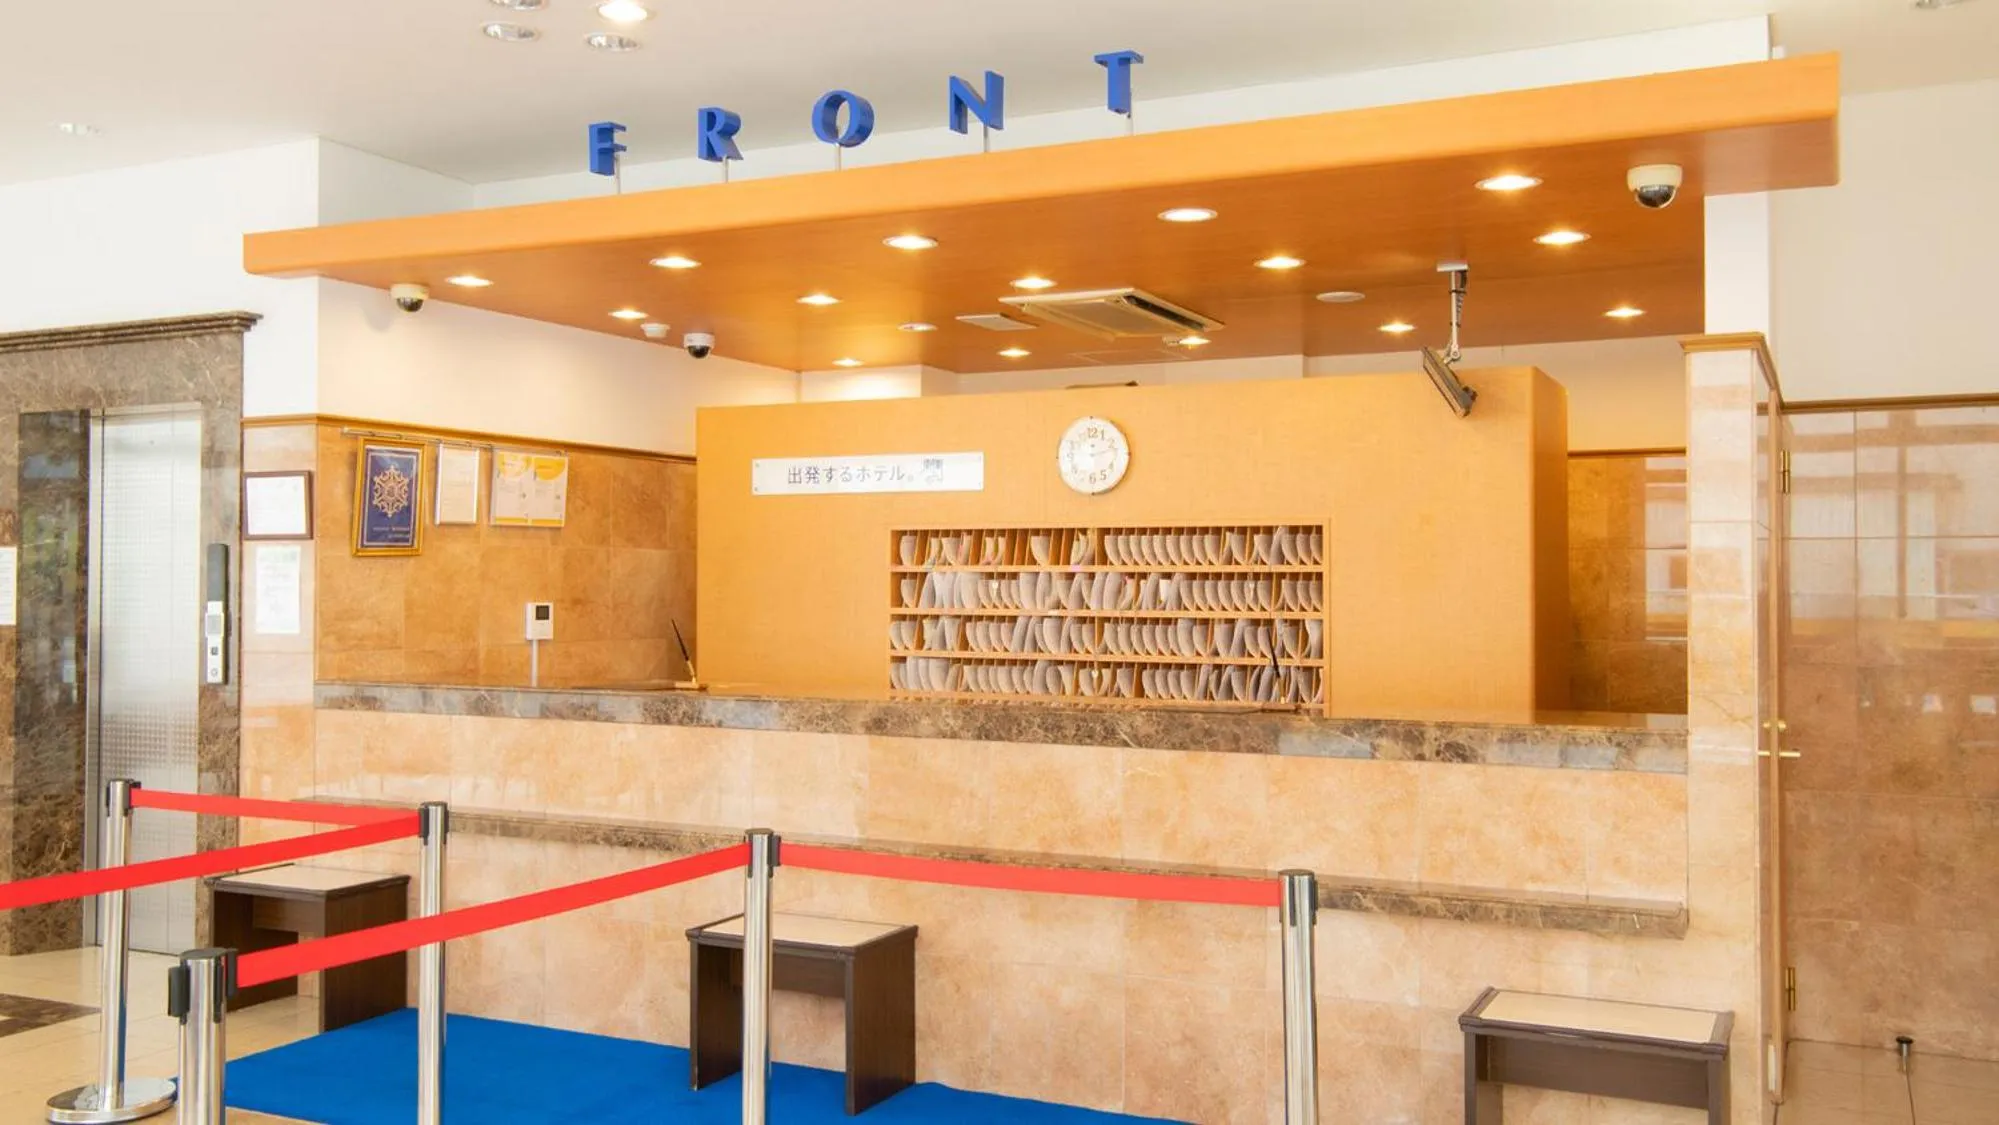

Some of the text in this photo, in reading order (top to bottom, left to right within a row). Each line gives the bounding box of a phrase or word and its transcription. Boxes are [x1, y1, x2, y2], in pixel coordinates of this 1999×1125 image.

[589, 50, 1143, 175] FRONT
[787, 465, 914, 485] 出発するホテル。
